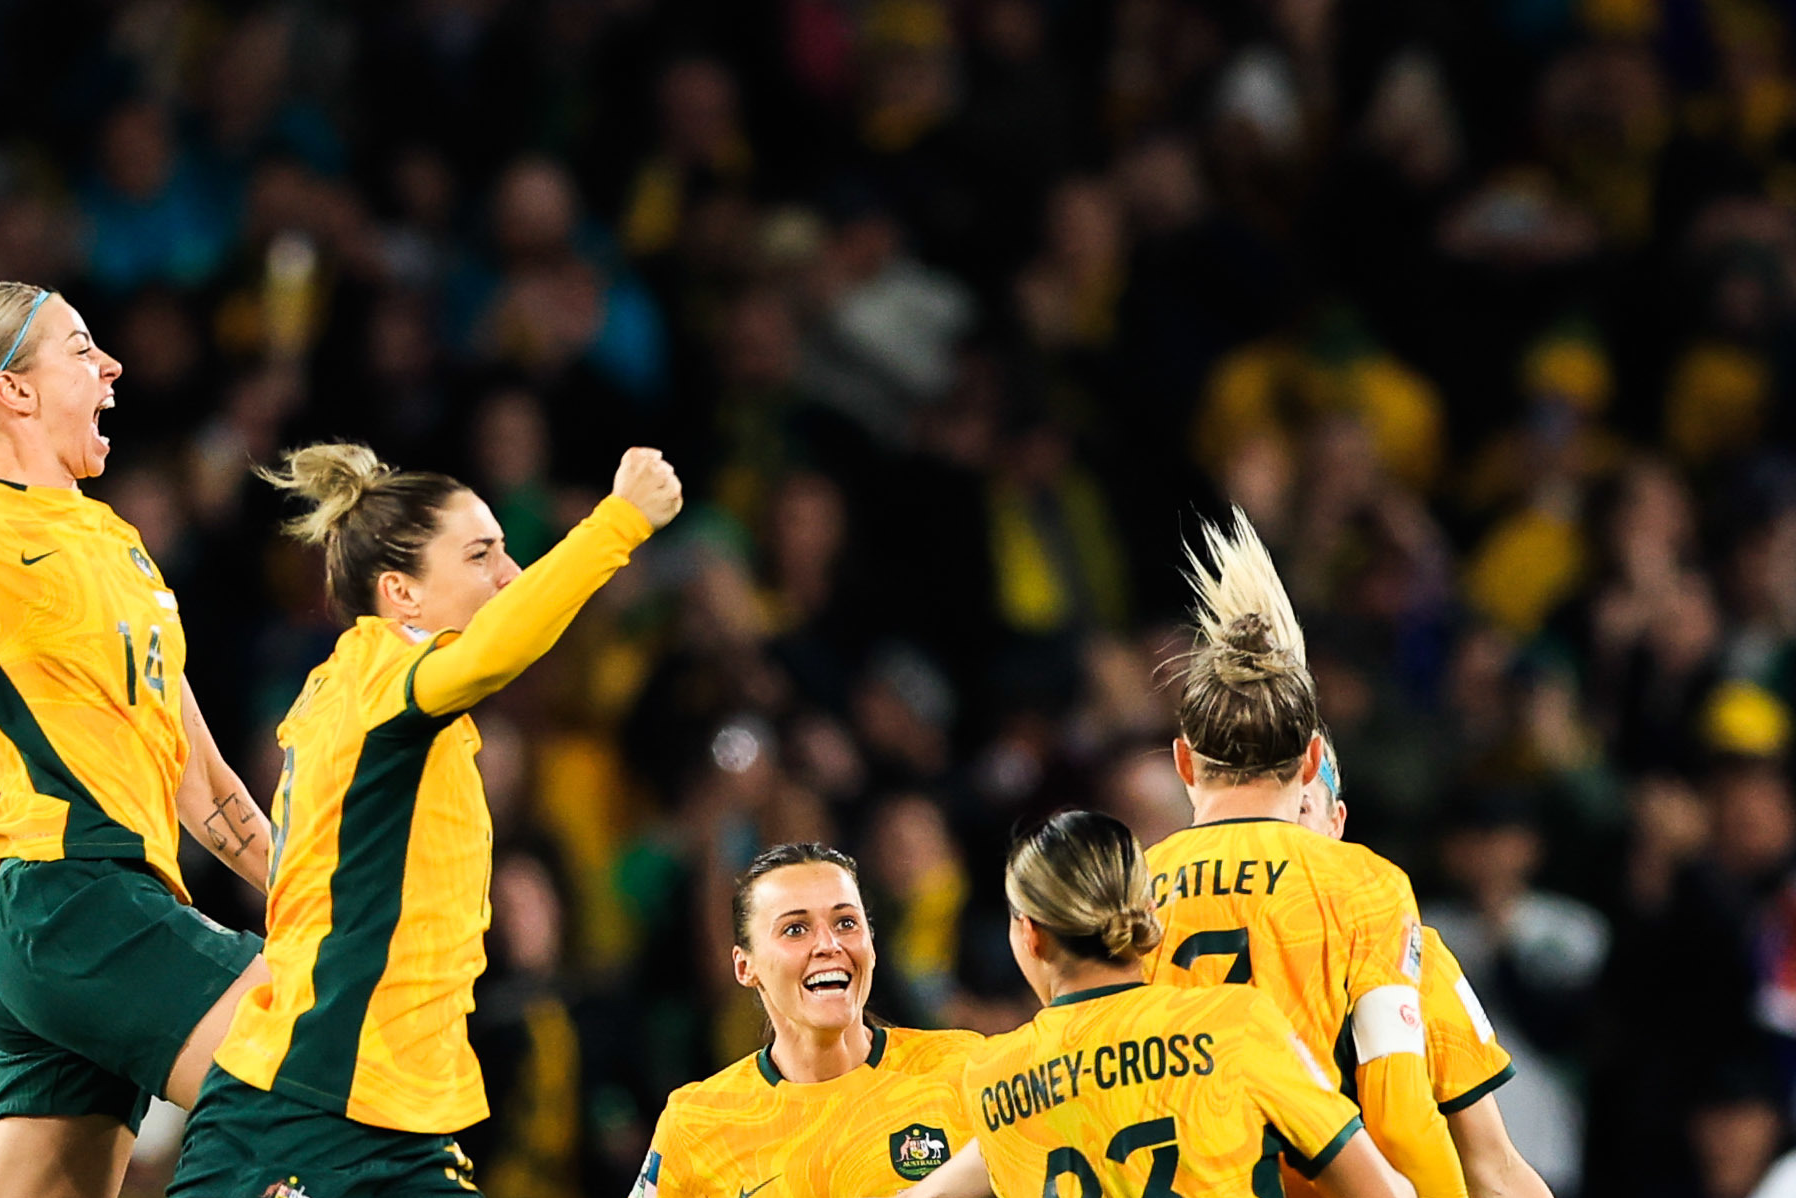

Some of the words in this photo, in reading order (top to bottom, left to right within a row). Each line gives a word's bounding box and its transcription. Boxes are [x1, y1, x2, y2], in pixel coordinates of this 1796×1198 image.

[117, 621, 165, 706] 14
[1151, 860, 1289, 908] CATLEY
[981, 1033, 1215, 1132] COONEY-CROSS
[902, 1159, 942, 1168] AUSTRALIA
